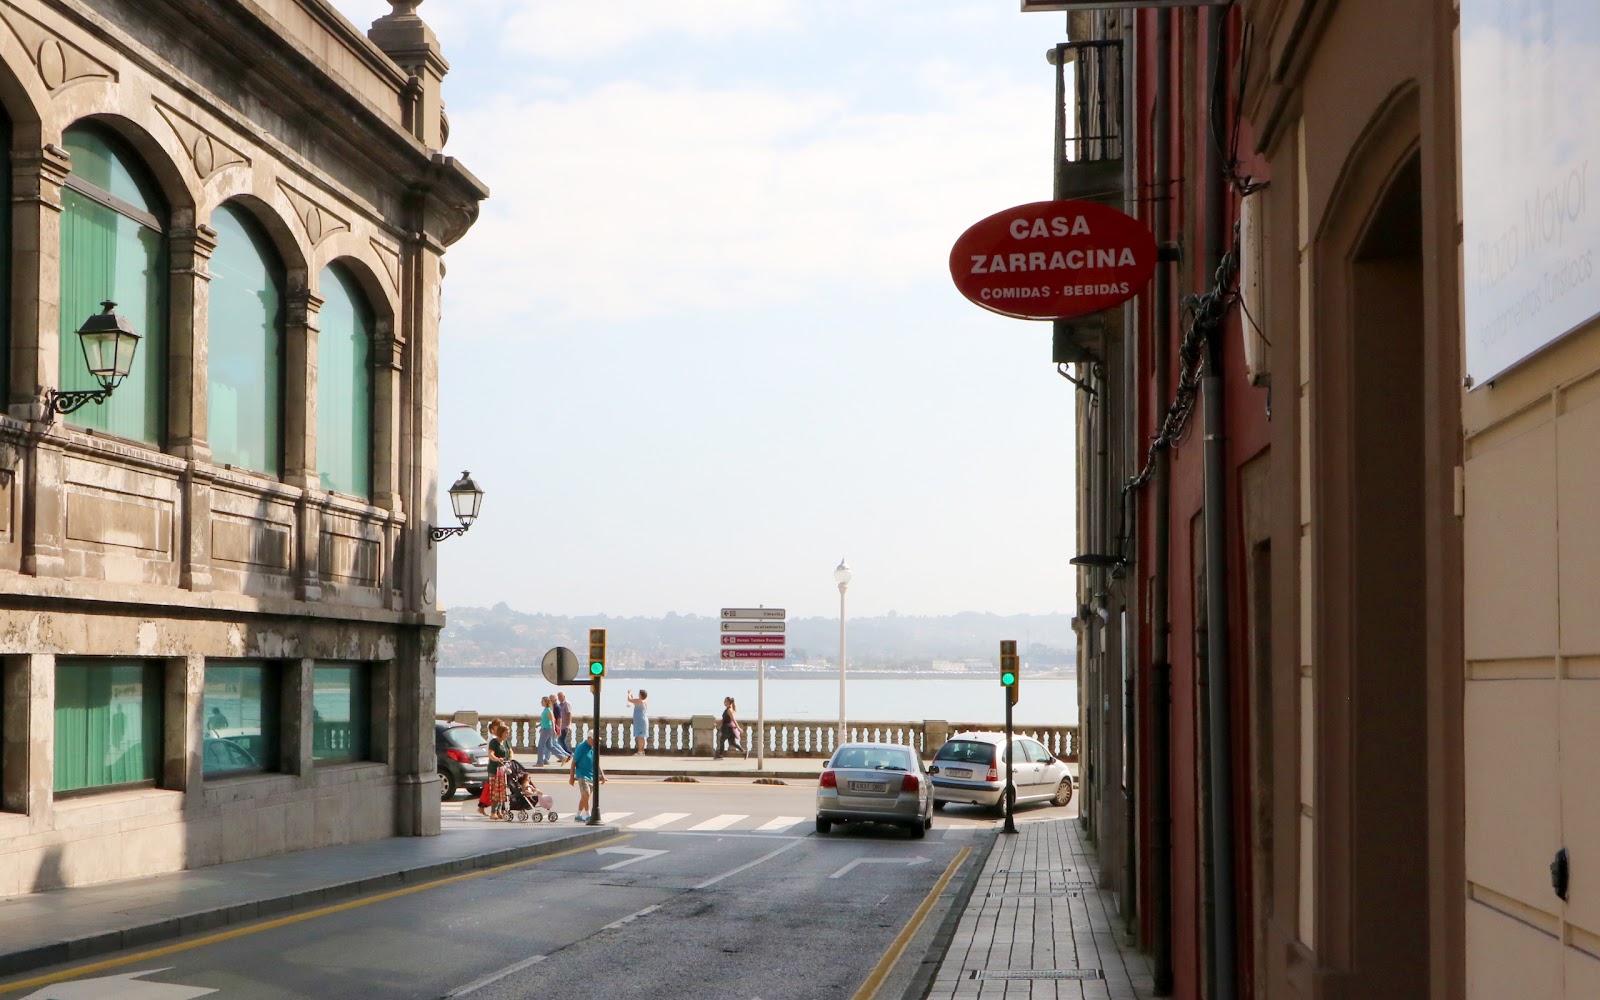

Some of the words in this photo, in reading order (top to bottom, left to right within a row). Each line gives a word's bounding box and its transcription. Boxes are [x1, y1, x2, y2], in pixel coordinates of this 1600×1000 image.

[1009, 215, 1091, 240] CASA
[1477, 223, 1518, 296] Plaza
[1524, 159, 1589, 262] Mayor
[970, 247, 1137, 274] ZARRACINA
[980, 285, 1051, 300] COMIDAS
[1063, 282, 1130, 297] BEBIDAS
